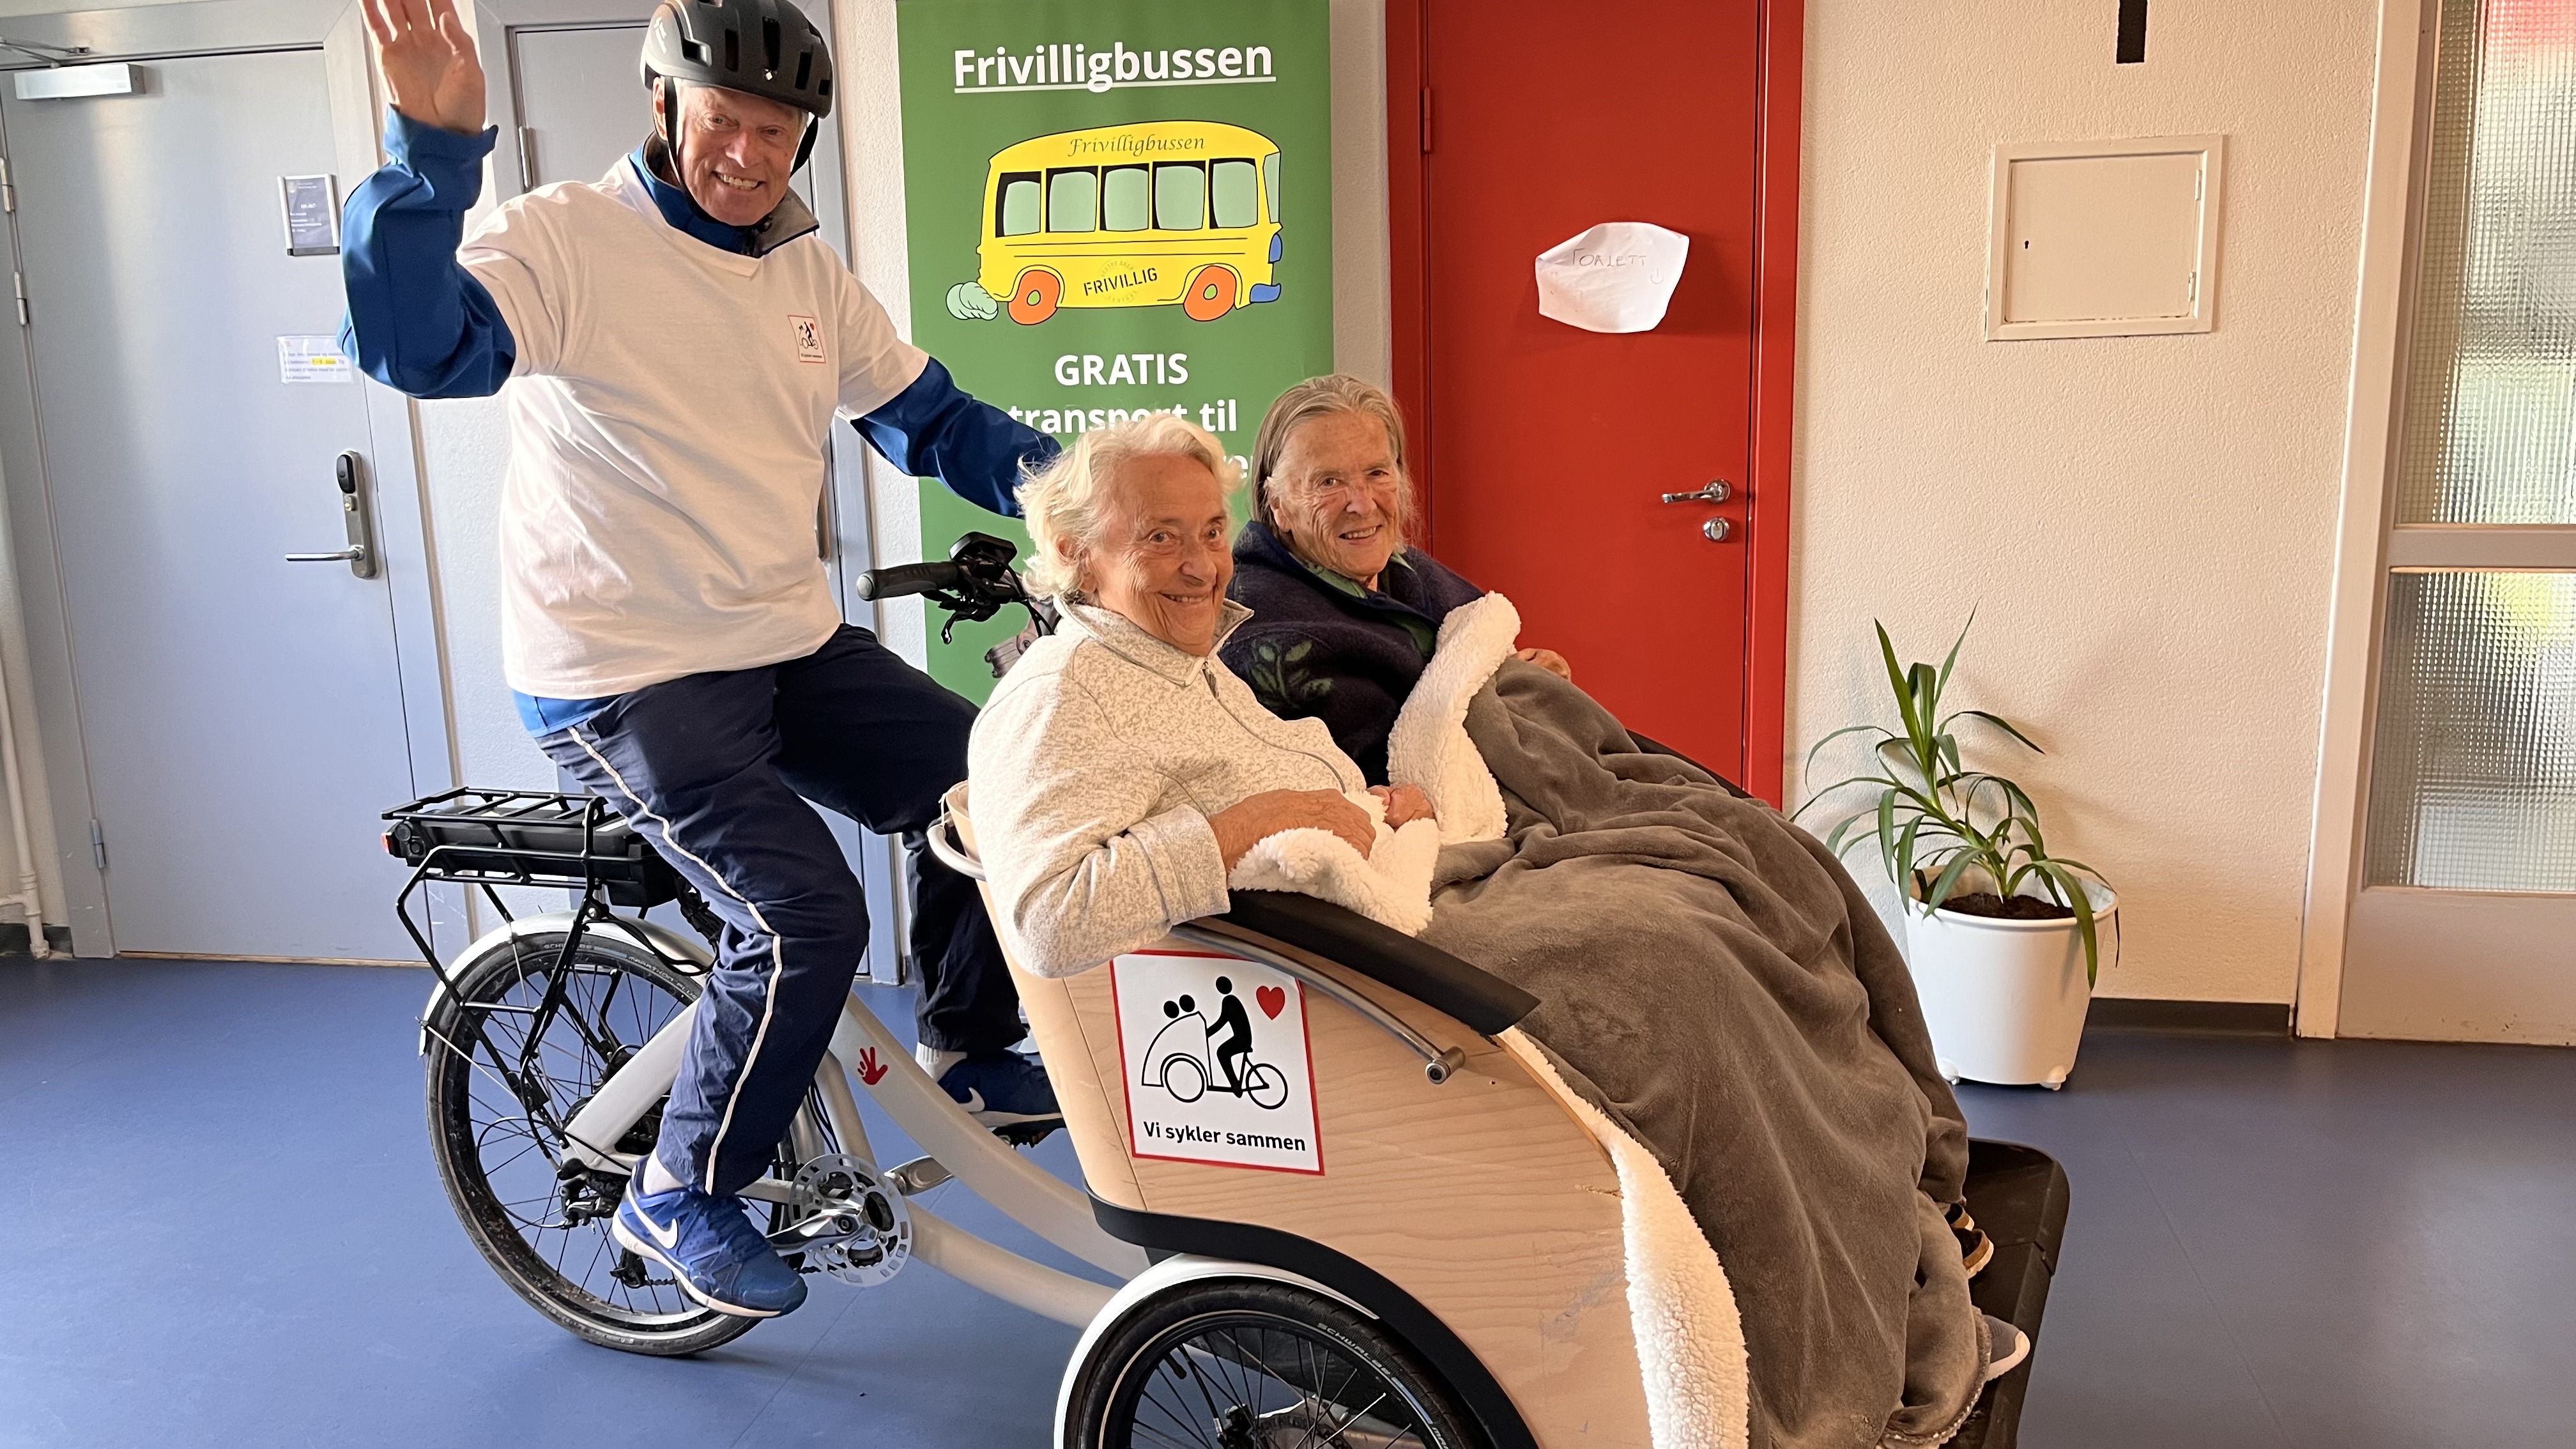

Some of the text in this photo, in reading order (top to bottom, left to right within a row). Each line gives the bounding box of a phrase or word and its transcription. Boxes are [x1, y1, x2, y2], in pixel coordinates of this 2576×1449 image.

[954, 42, 1273, 93] Frivilligbussen
[1068, 134, 1206, 157] Frivilligbussen
[1084, 267, 1158, 296] FRIVILLIG
[1055, 353, 1189, 386] GRATIS
[1008, 399, 1237, 433] transpt til
[1144, 1121, 1306, 1151] Vi sykler sammen
